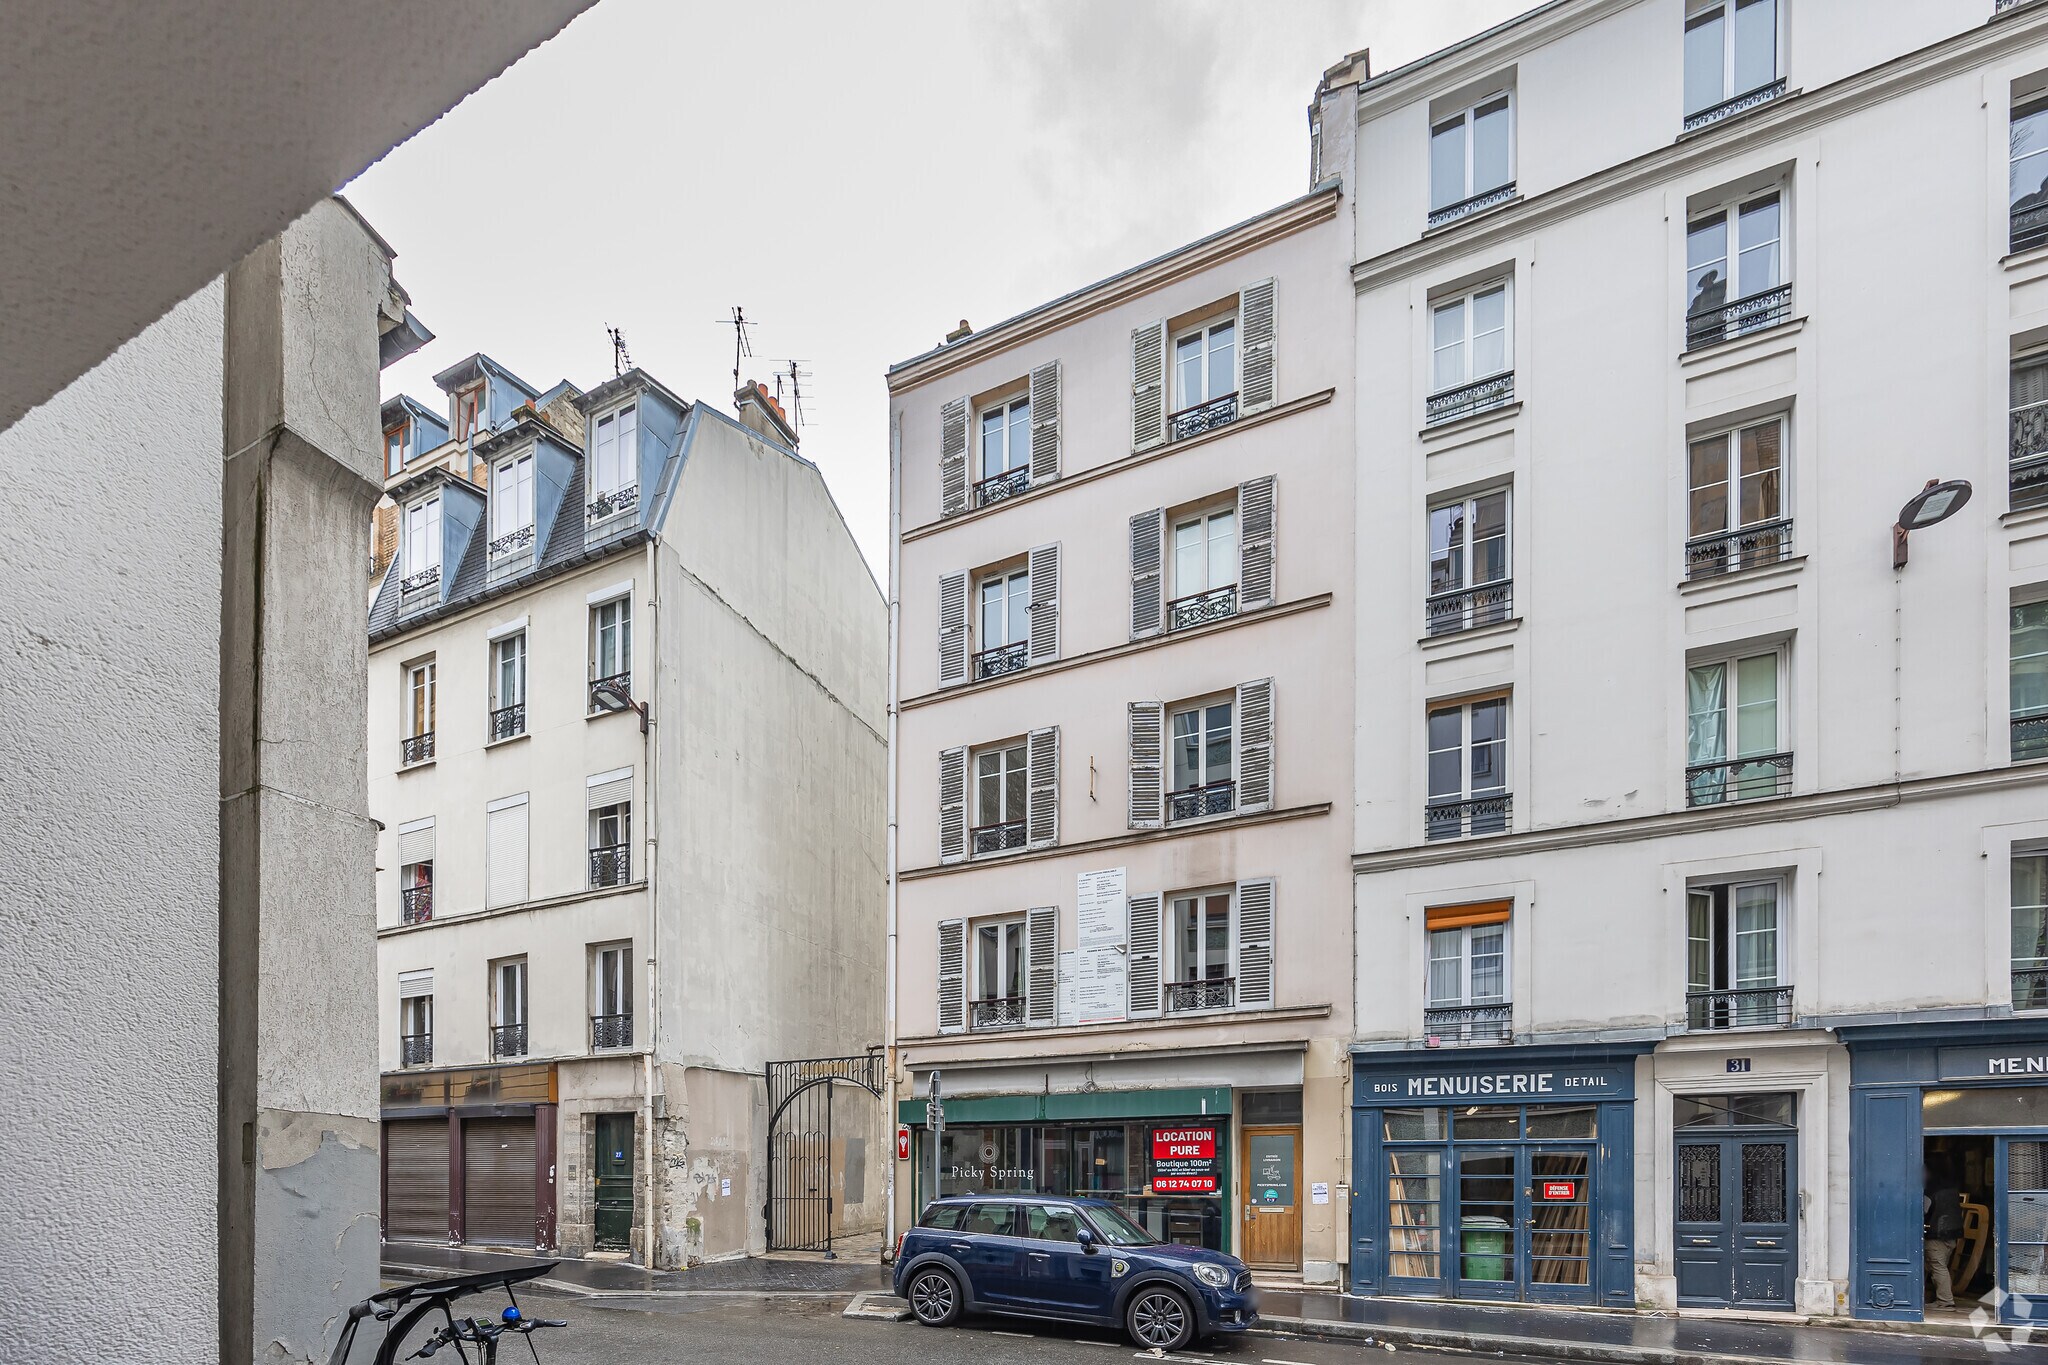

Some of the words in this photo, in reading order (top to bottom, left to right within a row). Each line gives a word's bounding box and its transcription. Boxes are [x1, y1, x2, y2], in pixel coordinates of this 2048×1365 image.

[1730, 1060, 1746, 1072] 31
[1989, 1057, 2048, 1074] MEN
[1374, 1083, 1398, 1093] BOIS
[1408, 1074, 1553, 1096] MENUISERIE
[1564, 1077, 1607, 1087] DETAIL
[1156, 1131, 1212, 1142] LOCATION
[1170, 1145, 1200, 1156] PURE
[1156, 1160, 1189, 1169] Boutique
[1190, 1159, 1212, 1168] 100m²
[952, 1166, 985, 1180] Picky
[990, 1166, 1034, 1180] Spring
[1156, 1180, 1167, 1188] 06
[1168, 1180, 1178, 1188] 12
[1178, 1180, 1190, 1188] 74
[1191, 1180, 1203, 1188] 07
[1203, 1179, 1213, 1188] 10
